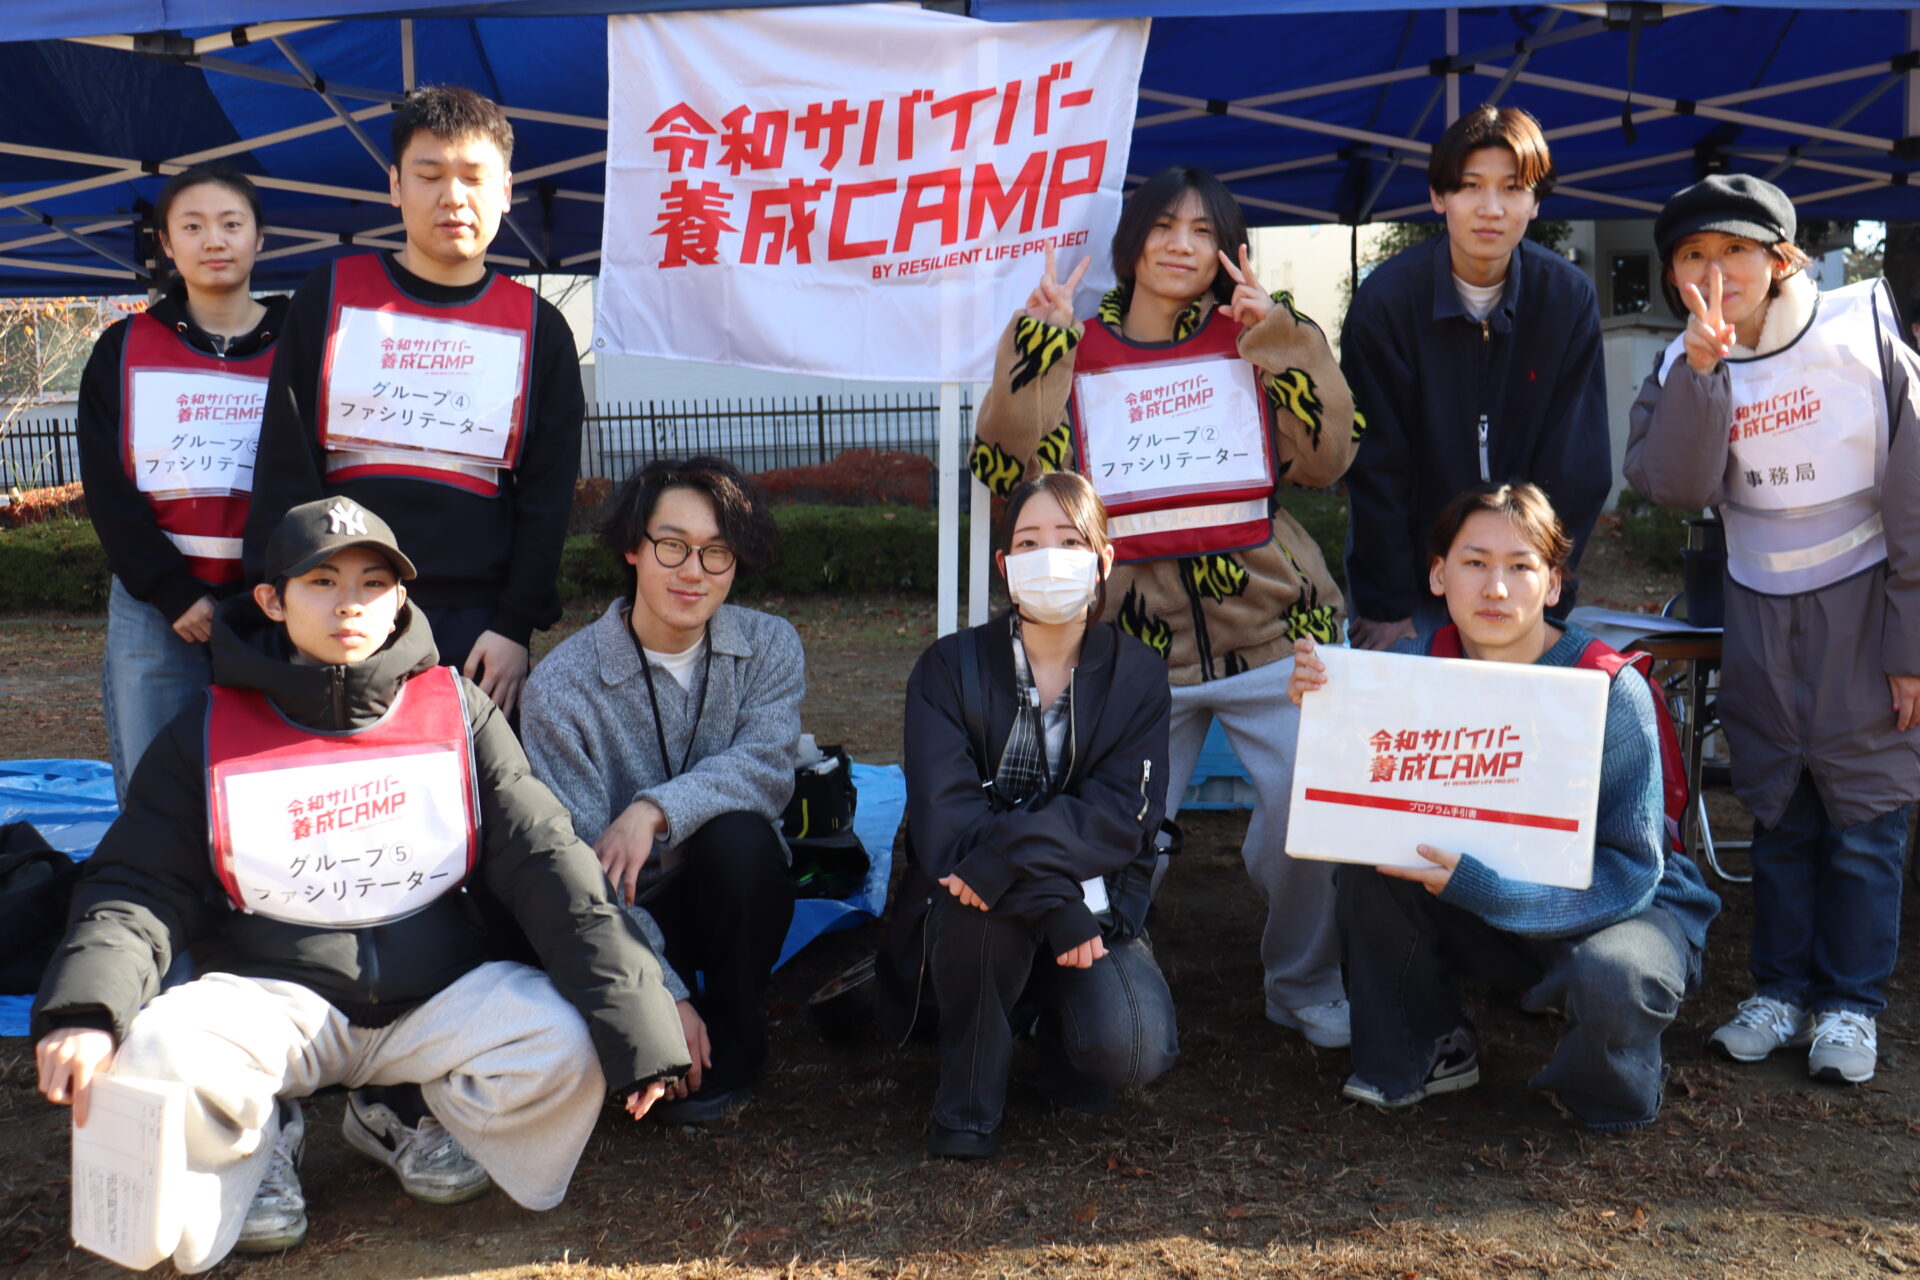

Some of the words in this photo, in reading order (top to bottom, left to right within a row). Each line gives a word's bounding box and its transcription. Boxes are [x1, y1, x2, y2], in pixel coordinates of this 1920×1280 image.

[646, 61, 1094, 176] 令和サバイバー
[650, 139, 1108, 270] 養成CAMP
[872, 264, 893, 279] BY
[898, 248, 982, 276] RESILIENT
[985, 244, 1019, 261] LIFE
[381, 337, 472, 352] 令和サバイバー
[381, 352, 475, 369] 養成CAMP
[176, 393, 264, 408] 令和サバイバー
[1125, 374, 1209, 407] 令和サバイバー
[1128, 387, 1214, 424] 養成CAMP
[1730, 385, 1815, 422] 和サバイバー
[340, 401, 494, 435] ファシリテーター
[1101, 448, 1249, 478] ファシリテーター
[1744, 462, 1816, 488] 事務局
[1368, 725, 1520, 753] 令和サバイバー
[1368, 751, 1523, 784] 養成CAMP
[286, 775, 400, 818] 令和サバイバー
[292, 792, 406, 841] 養成CAMP
[253, 870, 449, 904] ファシリテーター
